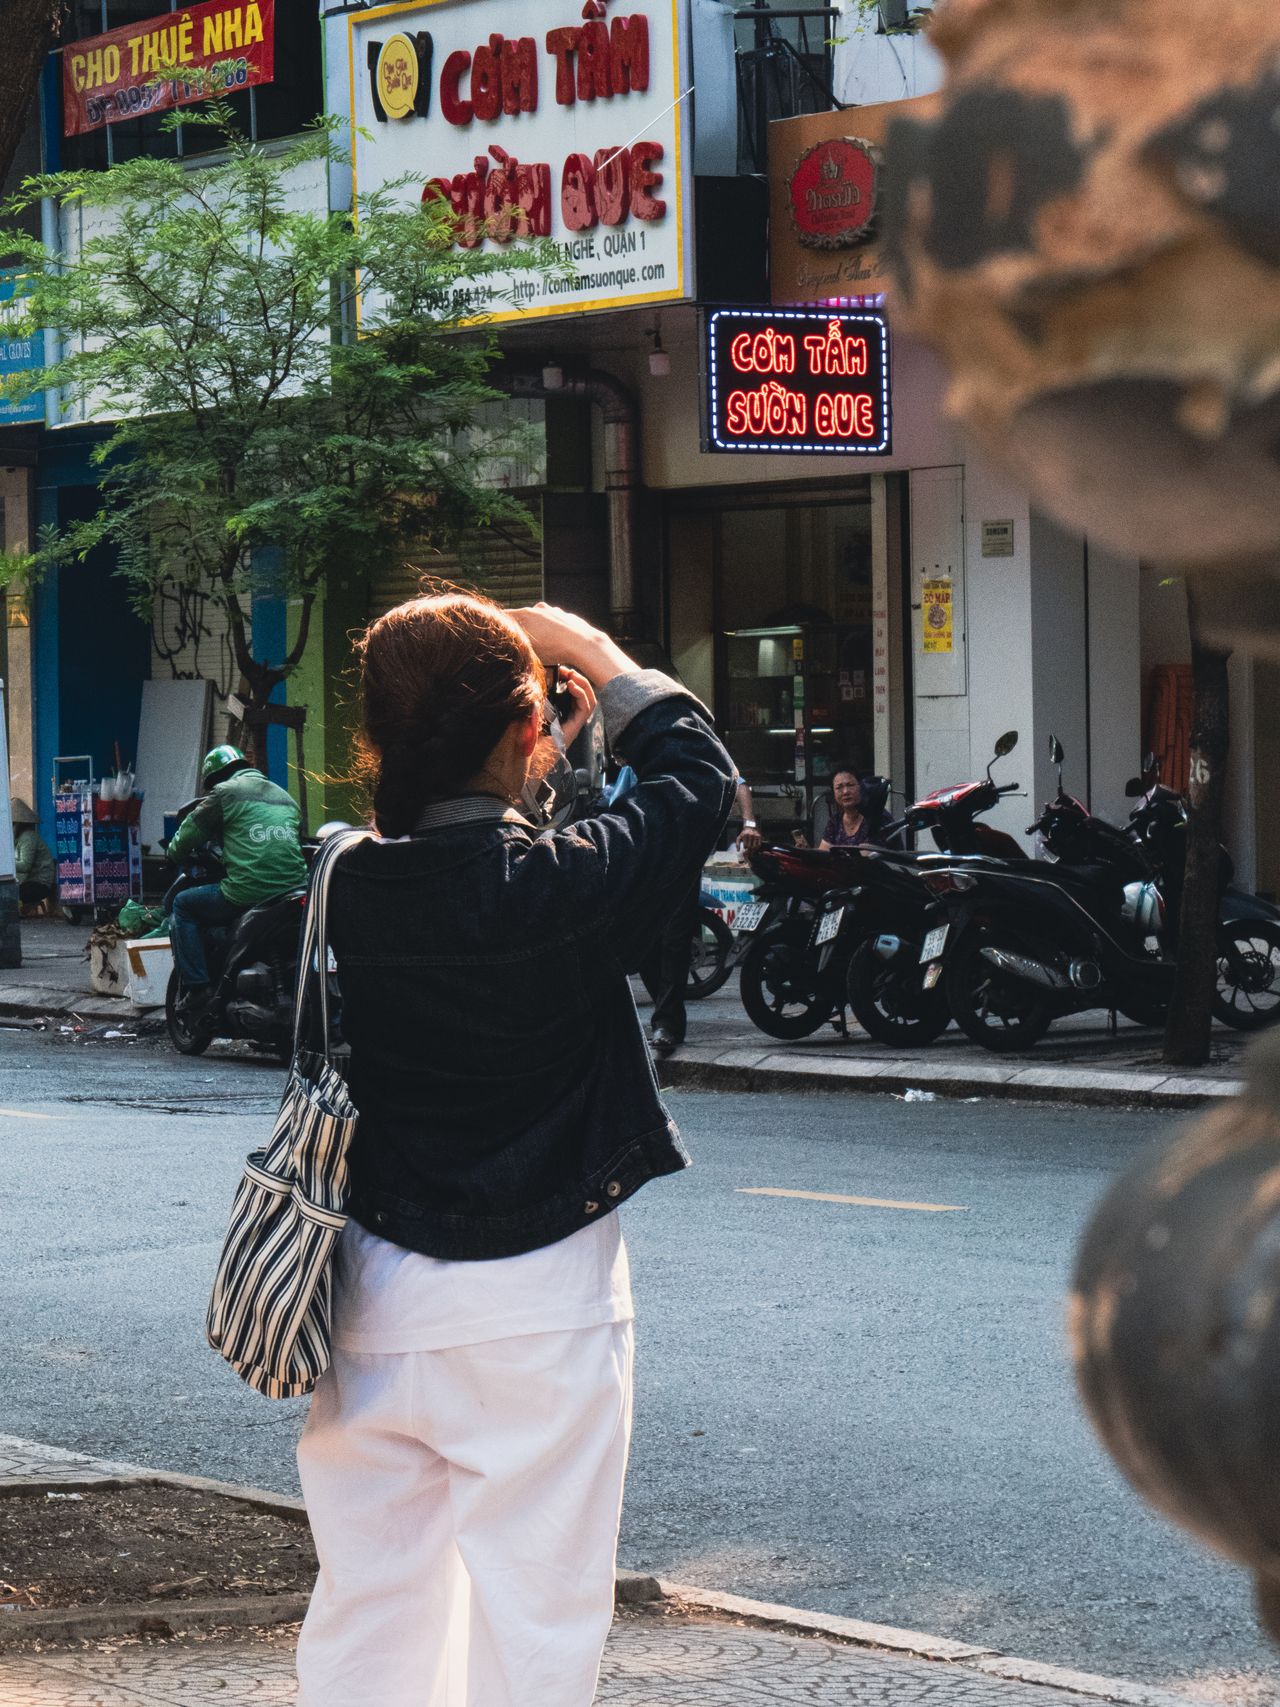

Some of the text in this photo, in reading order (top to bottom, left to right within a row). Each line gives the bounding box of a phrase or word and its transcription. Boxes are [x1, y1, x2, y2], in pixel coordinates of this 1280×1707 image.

[71, 44, 121, 93] CHO
[128, 13, 194, 77] THUÊ
[441, 0, 650, 126] CƠM TẤM
[561, 141, 667, 232] QUE
[603, 229, 637, 259] QUẬN
[640, 231, 646, 251] 1
[731, 319, 867, 375] CƠM TẤM
[727, 381, 875, 436] SƯỜN QUE
